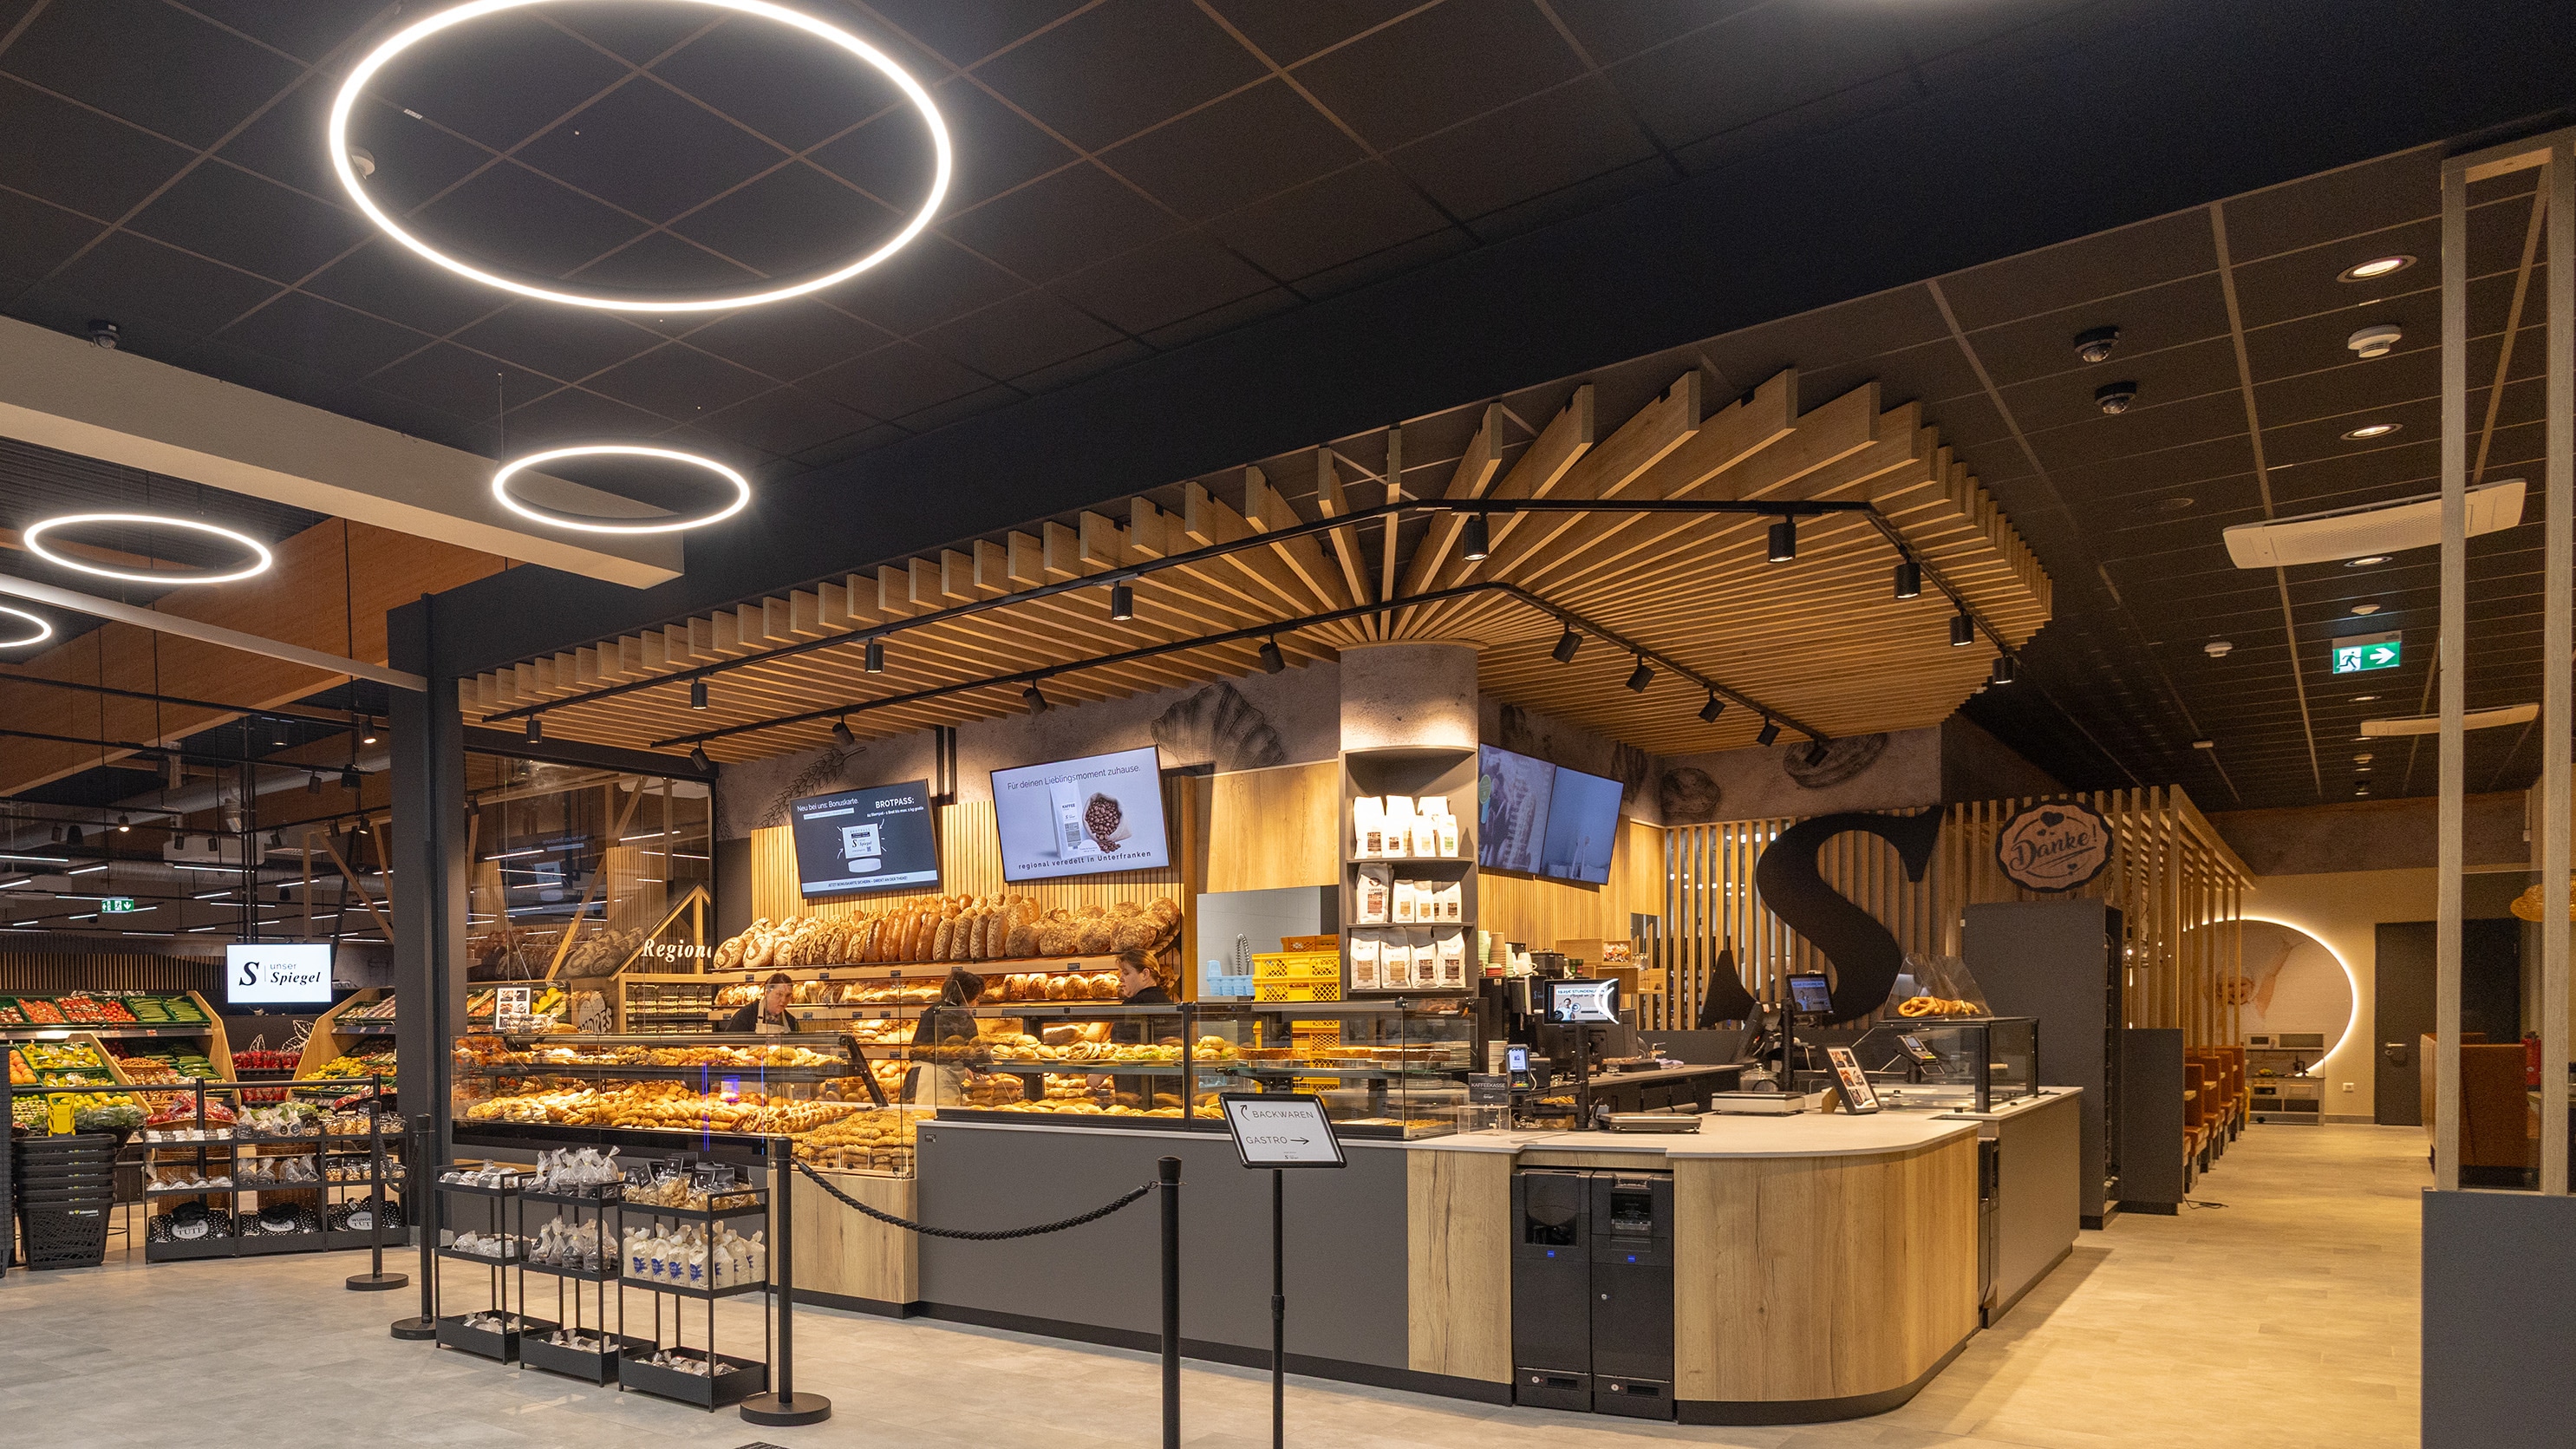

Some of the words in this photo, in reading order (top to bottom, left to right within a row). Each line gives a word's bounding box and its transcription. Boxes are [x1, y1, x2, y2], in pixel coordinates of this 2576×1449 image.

[1020, 779, 1044, 789] deinen
[1044, 769, 1106, 786] Lieblingsmoment
[1107, 764, 1141, 776] zuhause.
[829, 798, 858, 808] Bonuskarte.
[875, 797, 915, 809] BROTPASS:
[1018, 861, 1050, 870] regional
[1052, 858, 1085, 866] veredelt
[1097, 851, 1151, 862] Unterfranken
[1699, 805, 1946, 1027] S
[238, 961, 260, 986] S
[271, 971, 321, 986] Spiegel
[1252, 1110, 1314, 1119] BACKWAREN
[1245, 1136, 1288, 1145] GASTRO
